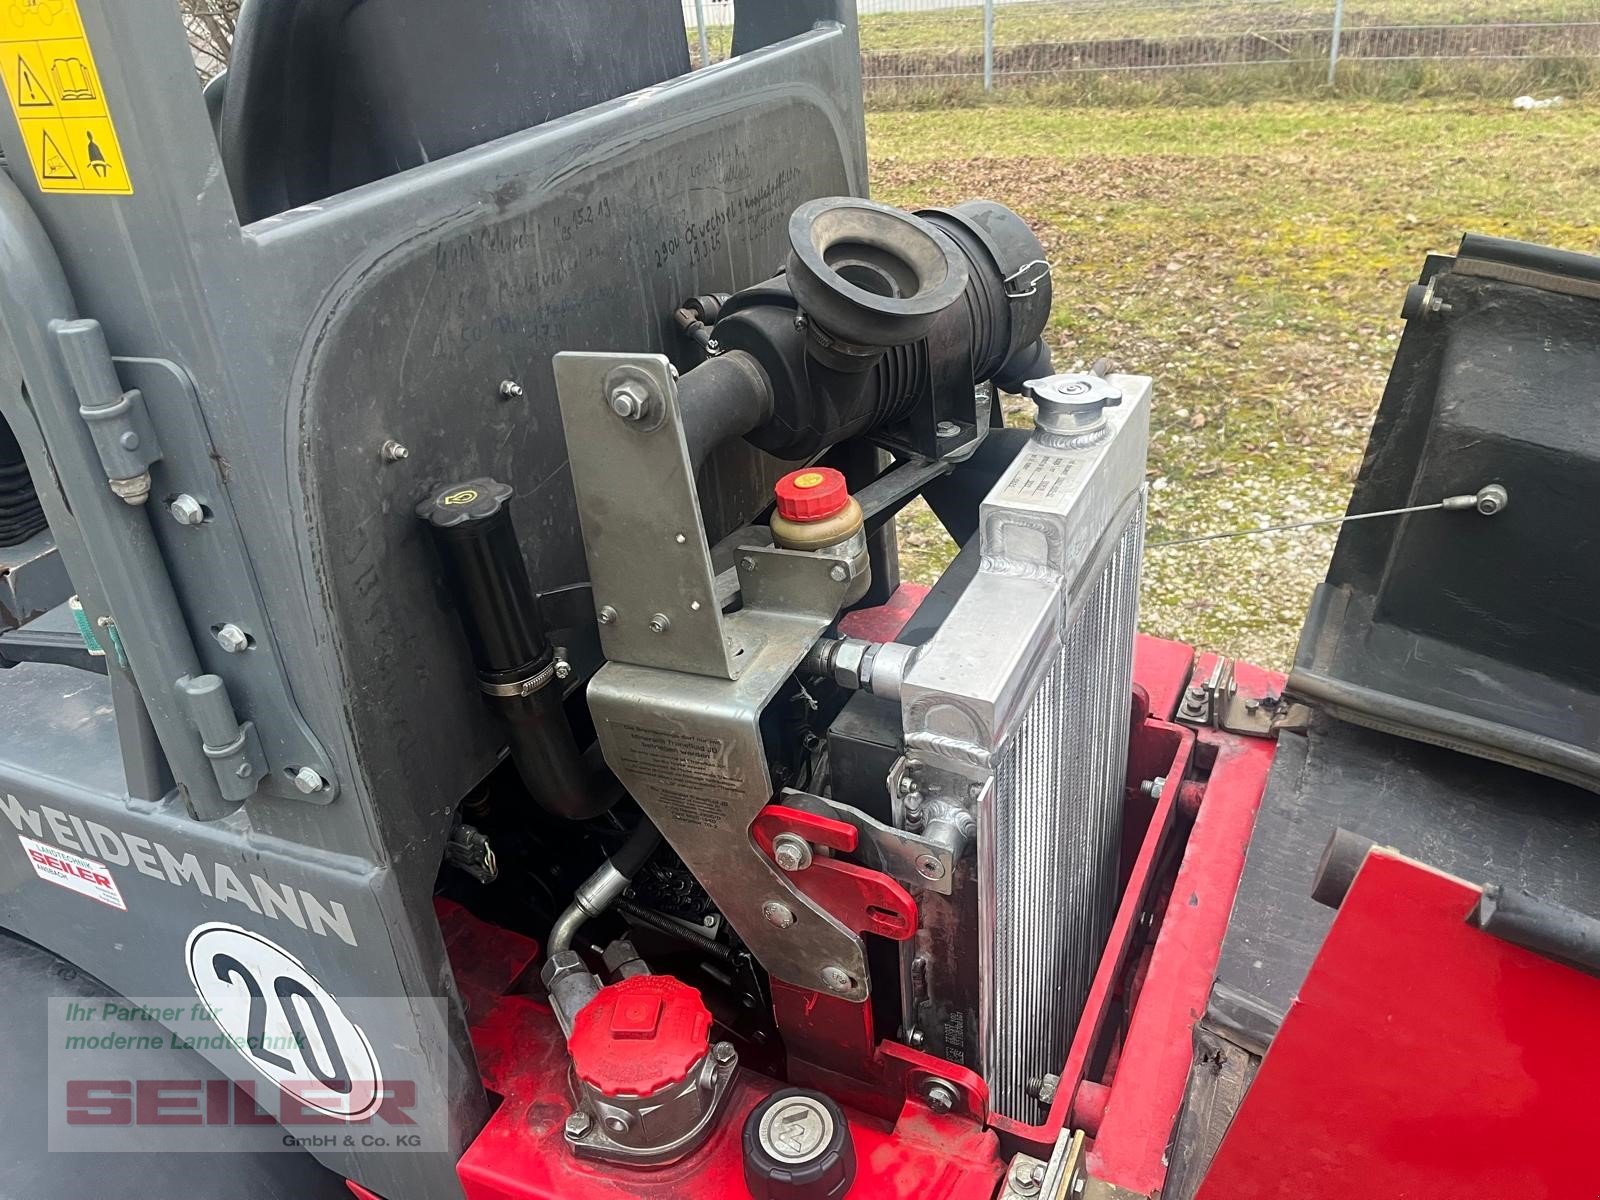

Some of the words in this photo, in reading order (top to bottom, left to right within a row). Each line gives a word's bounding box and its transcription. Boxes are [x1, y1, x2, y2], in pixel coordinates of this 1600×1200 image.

[0, 793, 358, 947] WEIDEMANN
[28, 848, 114, 890] SEILER
[212, 953, 352, 1094] 20
